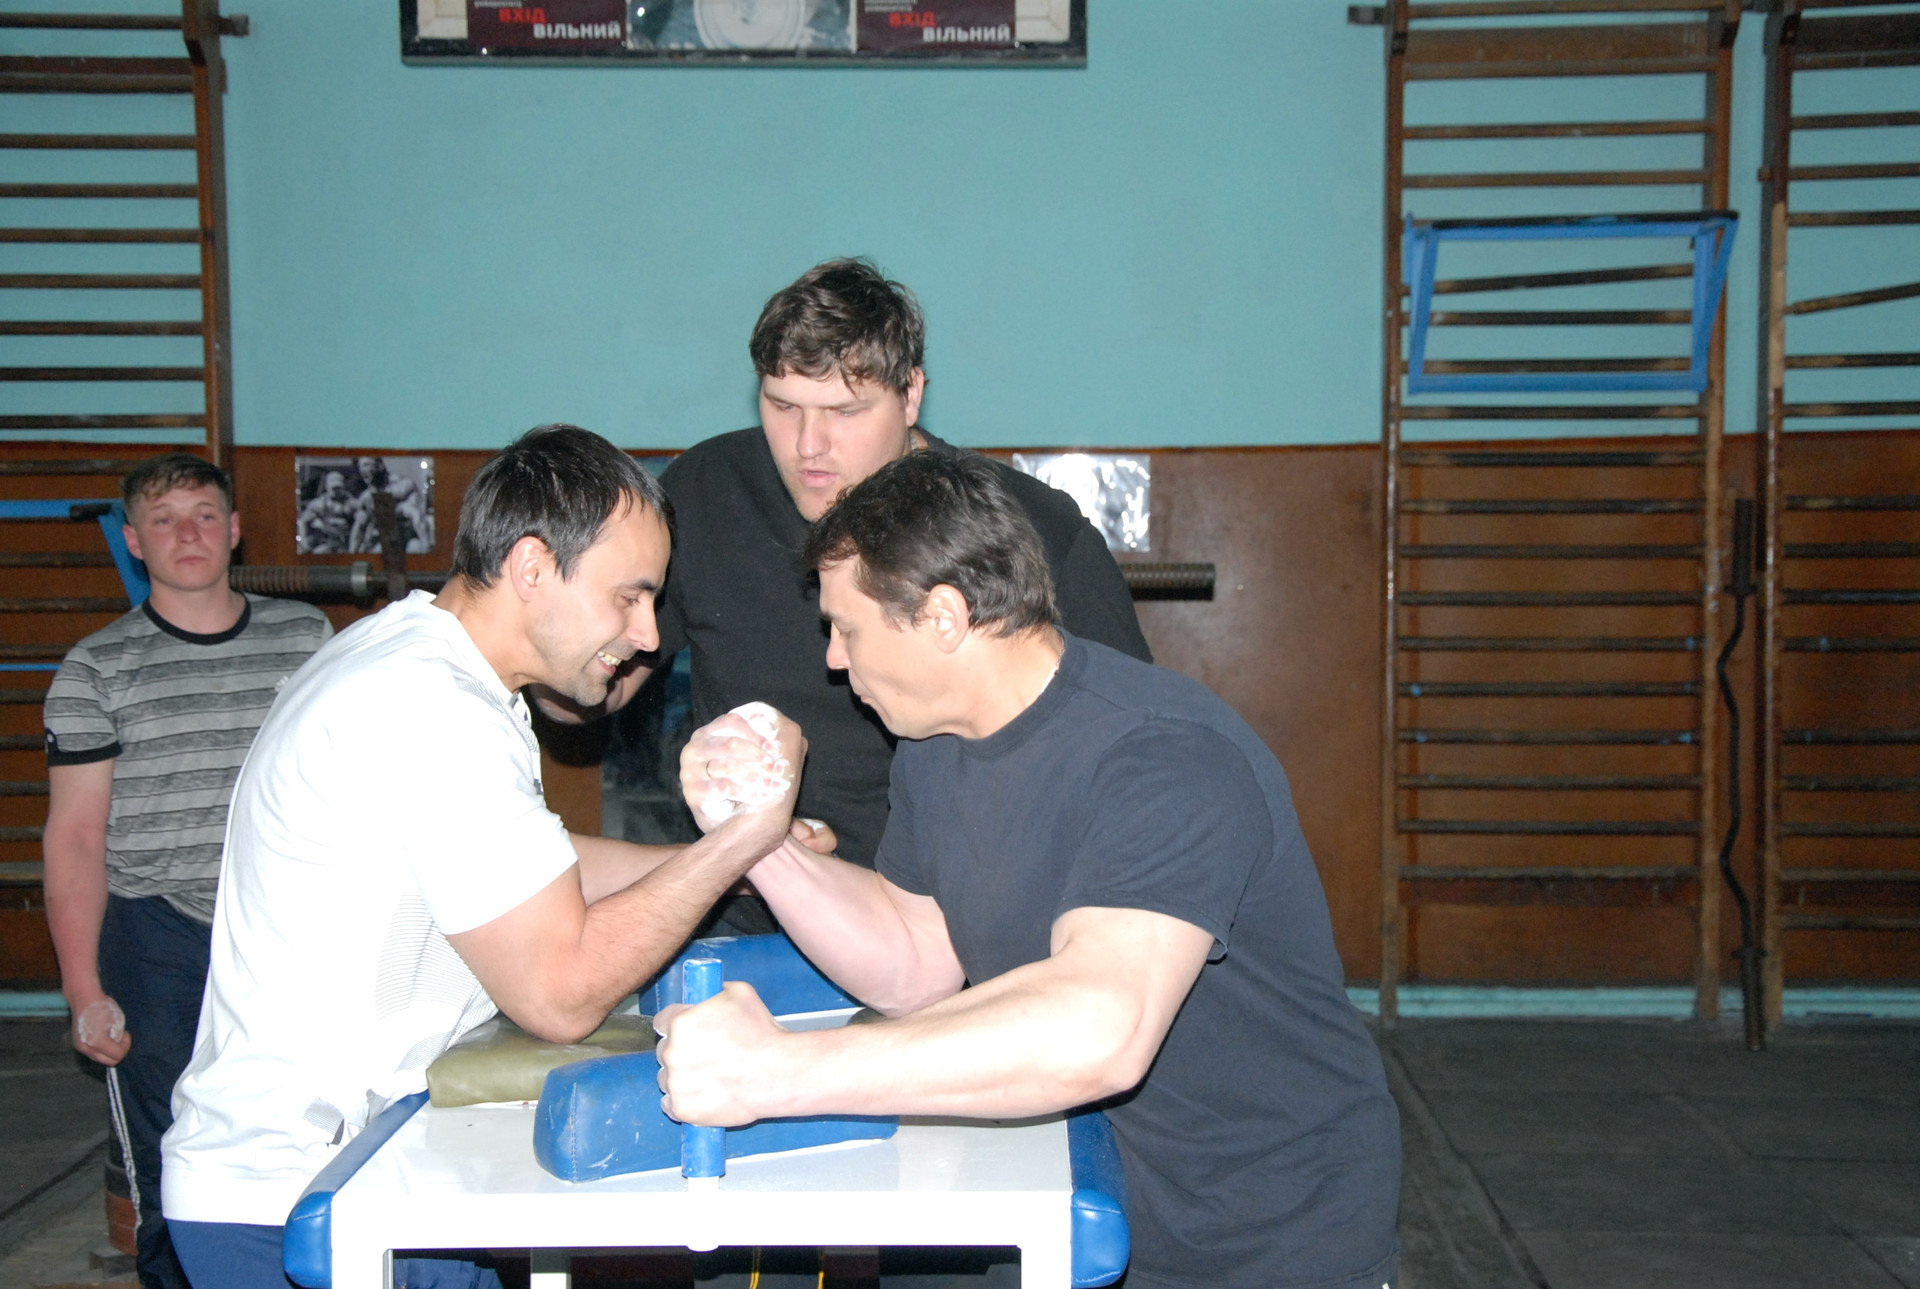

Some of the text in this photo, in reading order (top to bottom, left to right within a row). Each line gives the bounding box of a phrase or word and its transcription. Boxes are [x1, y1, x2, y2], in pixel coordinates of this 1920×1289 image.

[499, 8, 546, 23] ВХІД
[889, 12, 936, 27] ВХІД
[533, 21, 621, 39] ВІЛЬНИЙ
[923, 23, 1011, 42] ВІЛЬНИЙ
